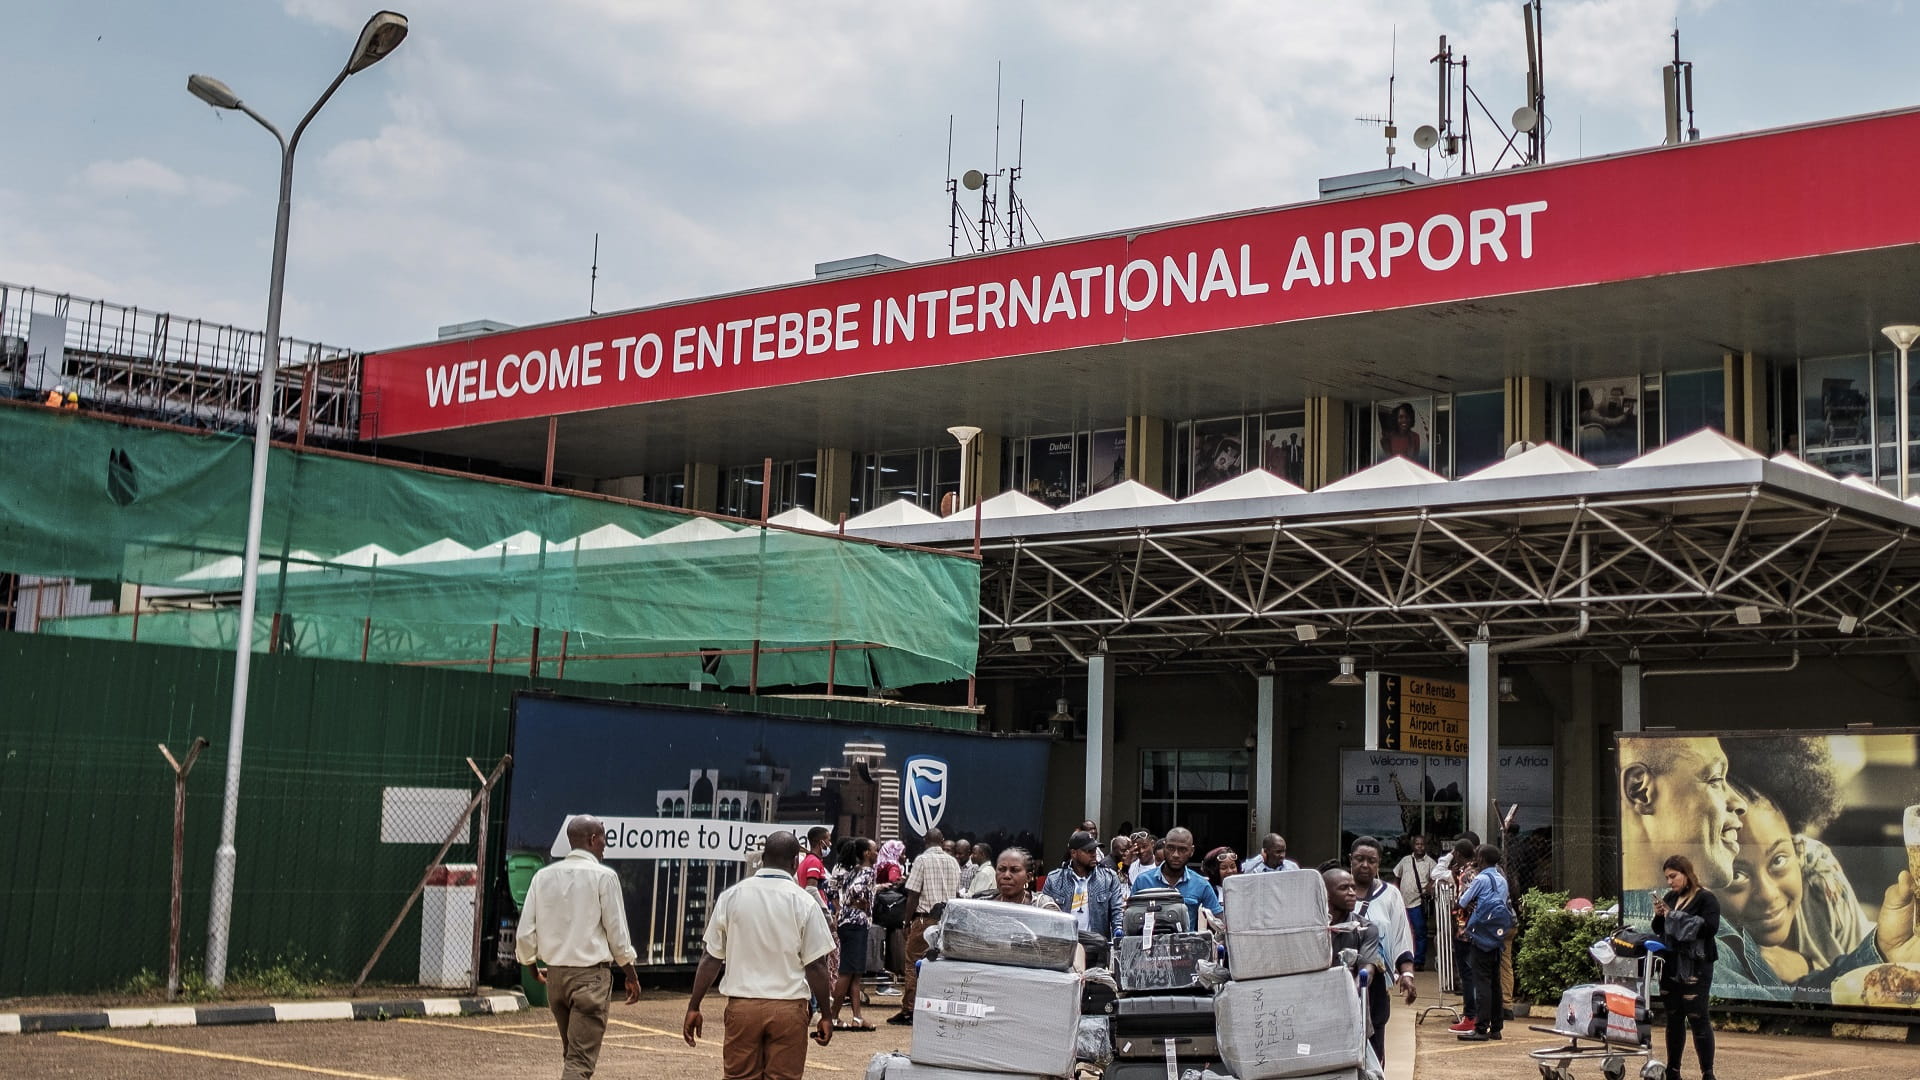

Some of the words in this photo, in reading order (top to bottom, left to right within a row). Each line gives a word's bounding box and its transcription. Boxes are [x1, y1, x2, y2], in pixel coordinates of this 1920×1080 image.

[425, 341, 603, 408] WELCOME
[611, 333, 663, 382] TO
[672, 303, 861, 373] ENTEBBE
[872, 243, 1270, 346] INTERNATIONAL
[1281, 200, 1548, 291] AIRPORT
[1410, 681, 1425, 695] Car
[1426, 682, 1456, 699] Rentals
[1410, 702, 1437, 715] Hotels
[1410, 717, 1440, 735] Airport
[1442, 720, 1459, 734] Taxi
[1410, 735, 1444, 750] Meeters
[1446, 740, 1452, 751] &
[1370, 755, 1419, 767] Welcome
[1429, 757, 1441, 767] to
[1443, 756, 1461, 767] the
[1500, 756, 1513, 767] of
[1515, 756, 1549, 767] Africa
[1356, 784, 1380, 794] UTB
[697, 824, 721, 850] to
[728, 825, 808, 854] Ugaa
